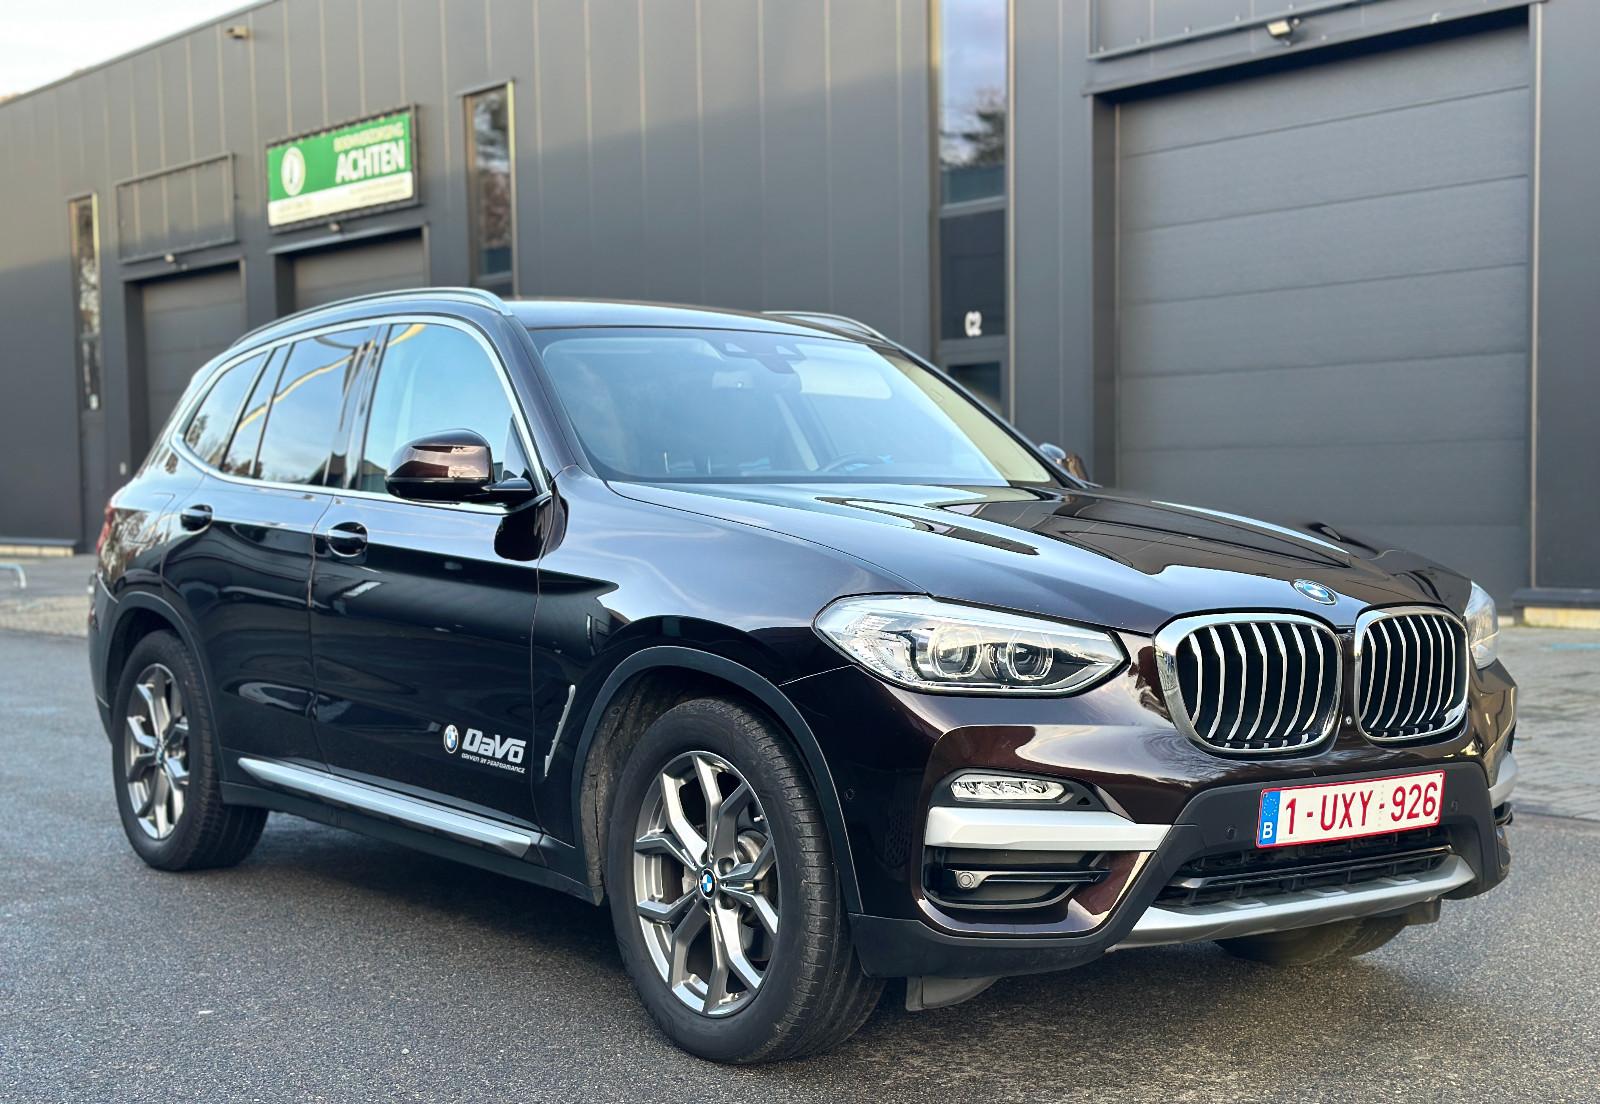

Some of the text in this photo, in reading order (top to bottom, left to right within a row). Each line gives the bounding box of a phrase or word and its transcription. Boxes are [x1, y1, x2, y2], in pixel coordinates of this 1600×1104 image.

[335, 139, 405, 184] ACHTEN
[1262, 821, 1273, 839] B
[1285, 781, 1438, 835] 1-UXY-926
